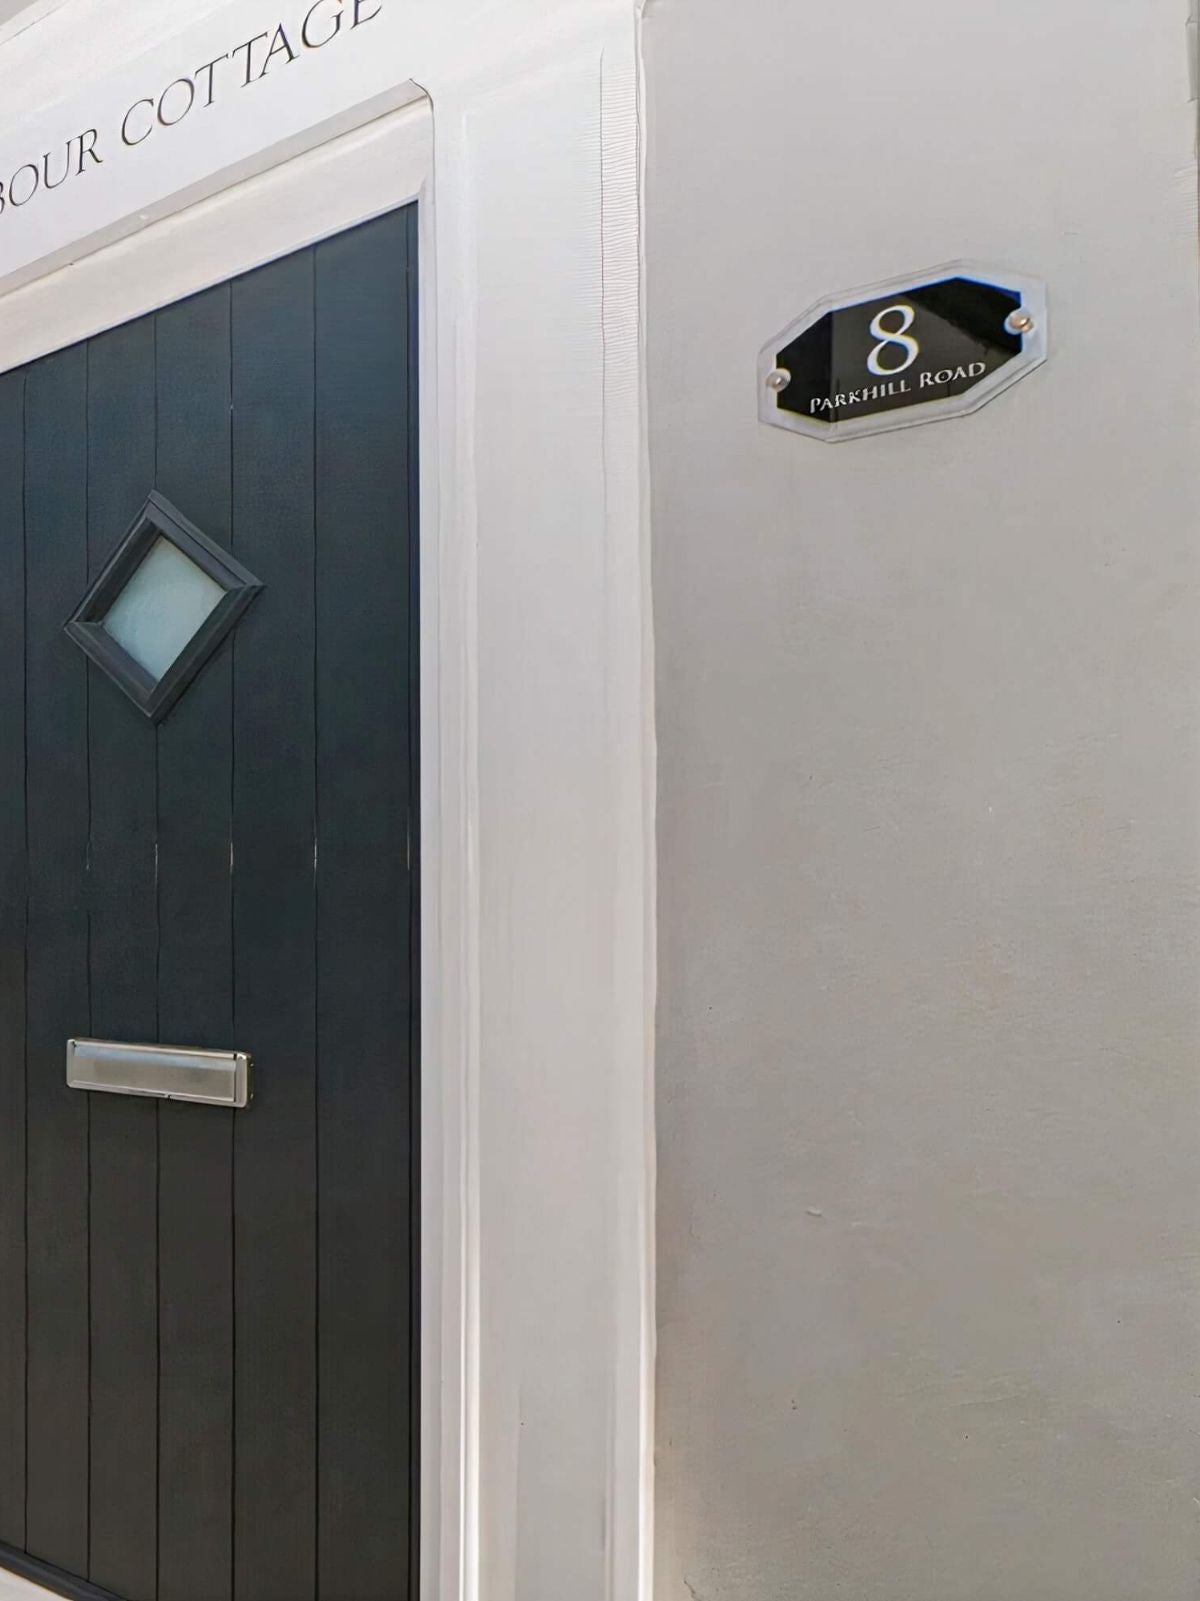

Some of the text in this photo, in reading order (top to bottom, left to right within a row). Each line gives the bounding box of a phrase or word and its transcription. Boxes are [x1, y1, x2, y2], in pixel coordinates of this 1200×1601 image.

[866, 304, 919, 376] 8
[809, 362, 986, 414] PARKHILL ROAD
